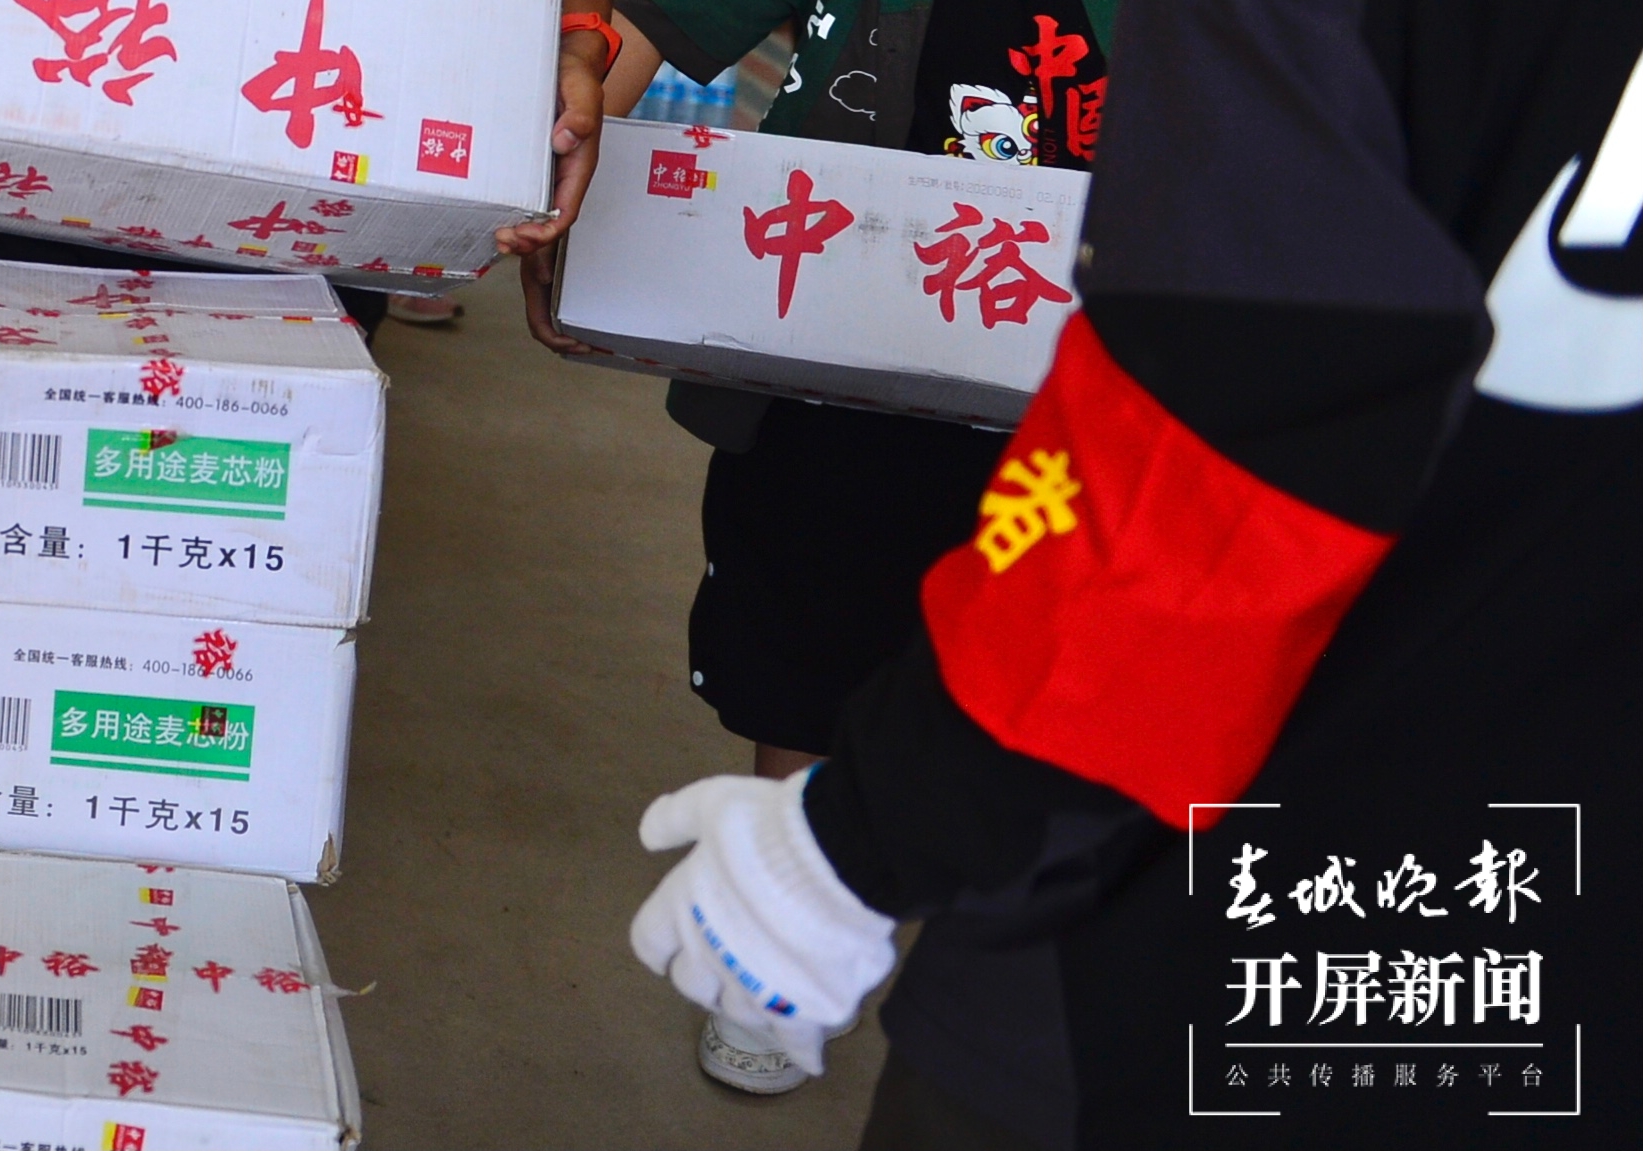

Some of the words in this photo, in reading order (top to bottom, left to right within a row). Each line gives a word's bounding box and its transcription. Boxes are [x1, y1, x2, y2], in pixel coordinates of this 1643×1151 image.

[174, 395, 290, 417] 400-186-0066
[93, 444, 286, 490] 多用途麦芯粉
[975, 447, 1082, 575] 者
[116, 532, 285, 573] 1千克x15
[59, 705, 250, 753] 多用途麦芯粉
[84, 794, 250, 836] 1千克x15
